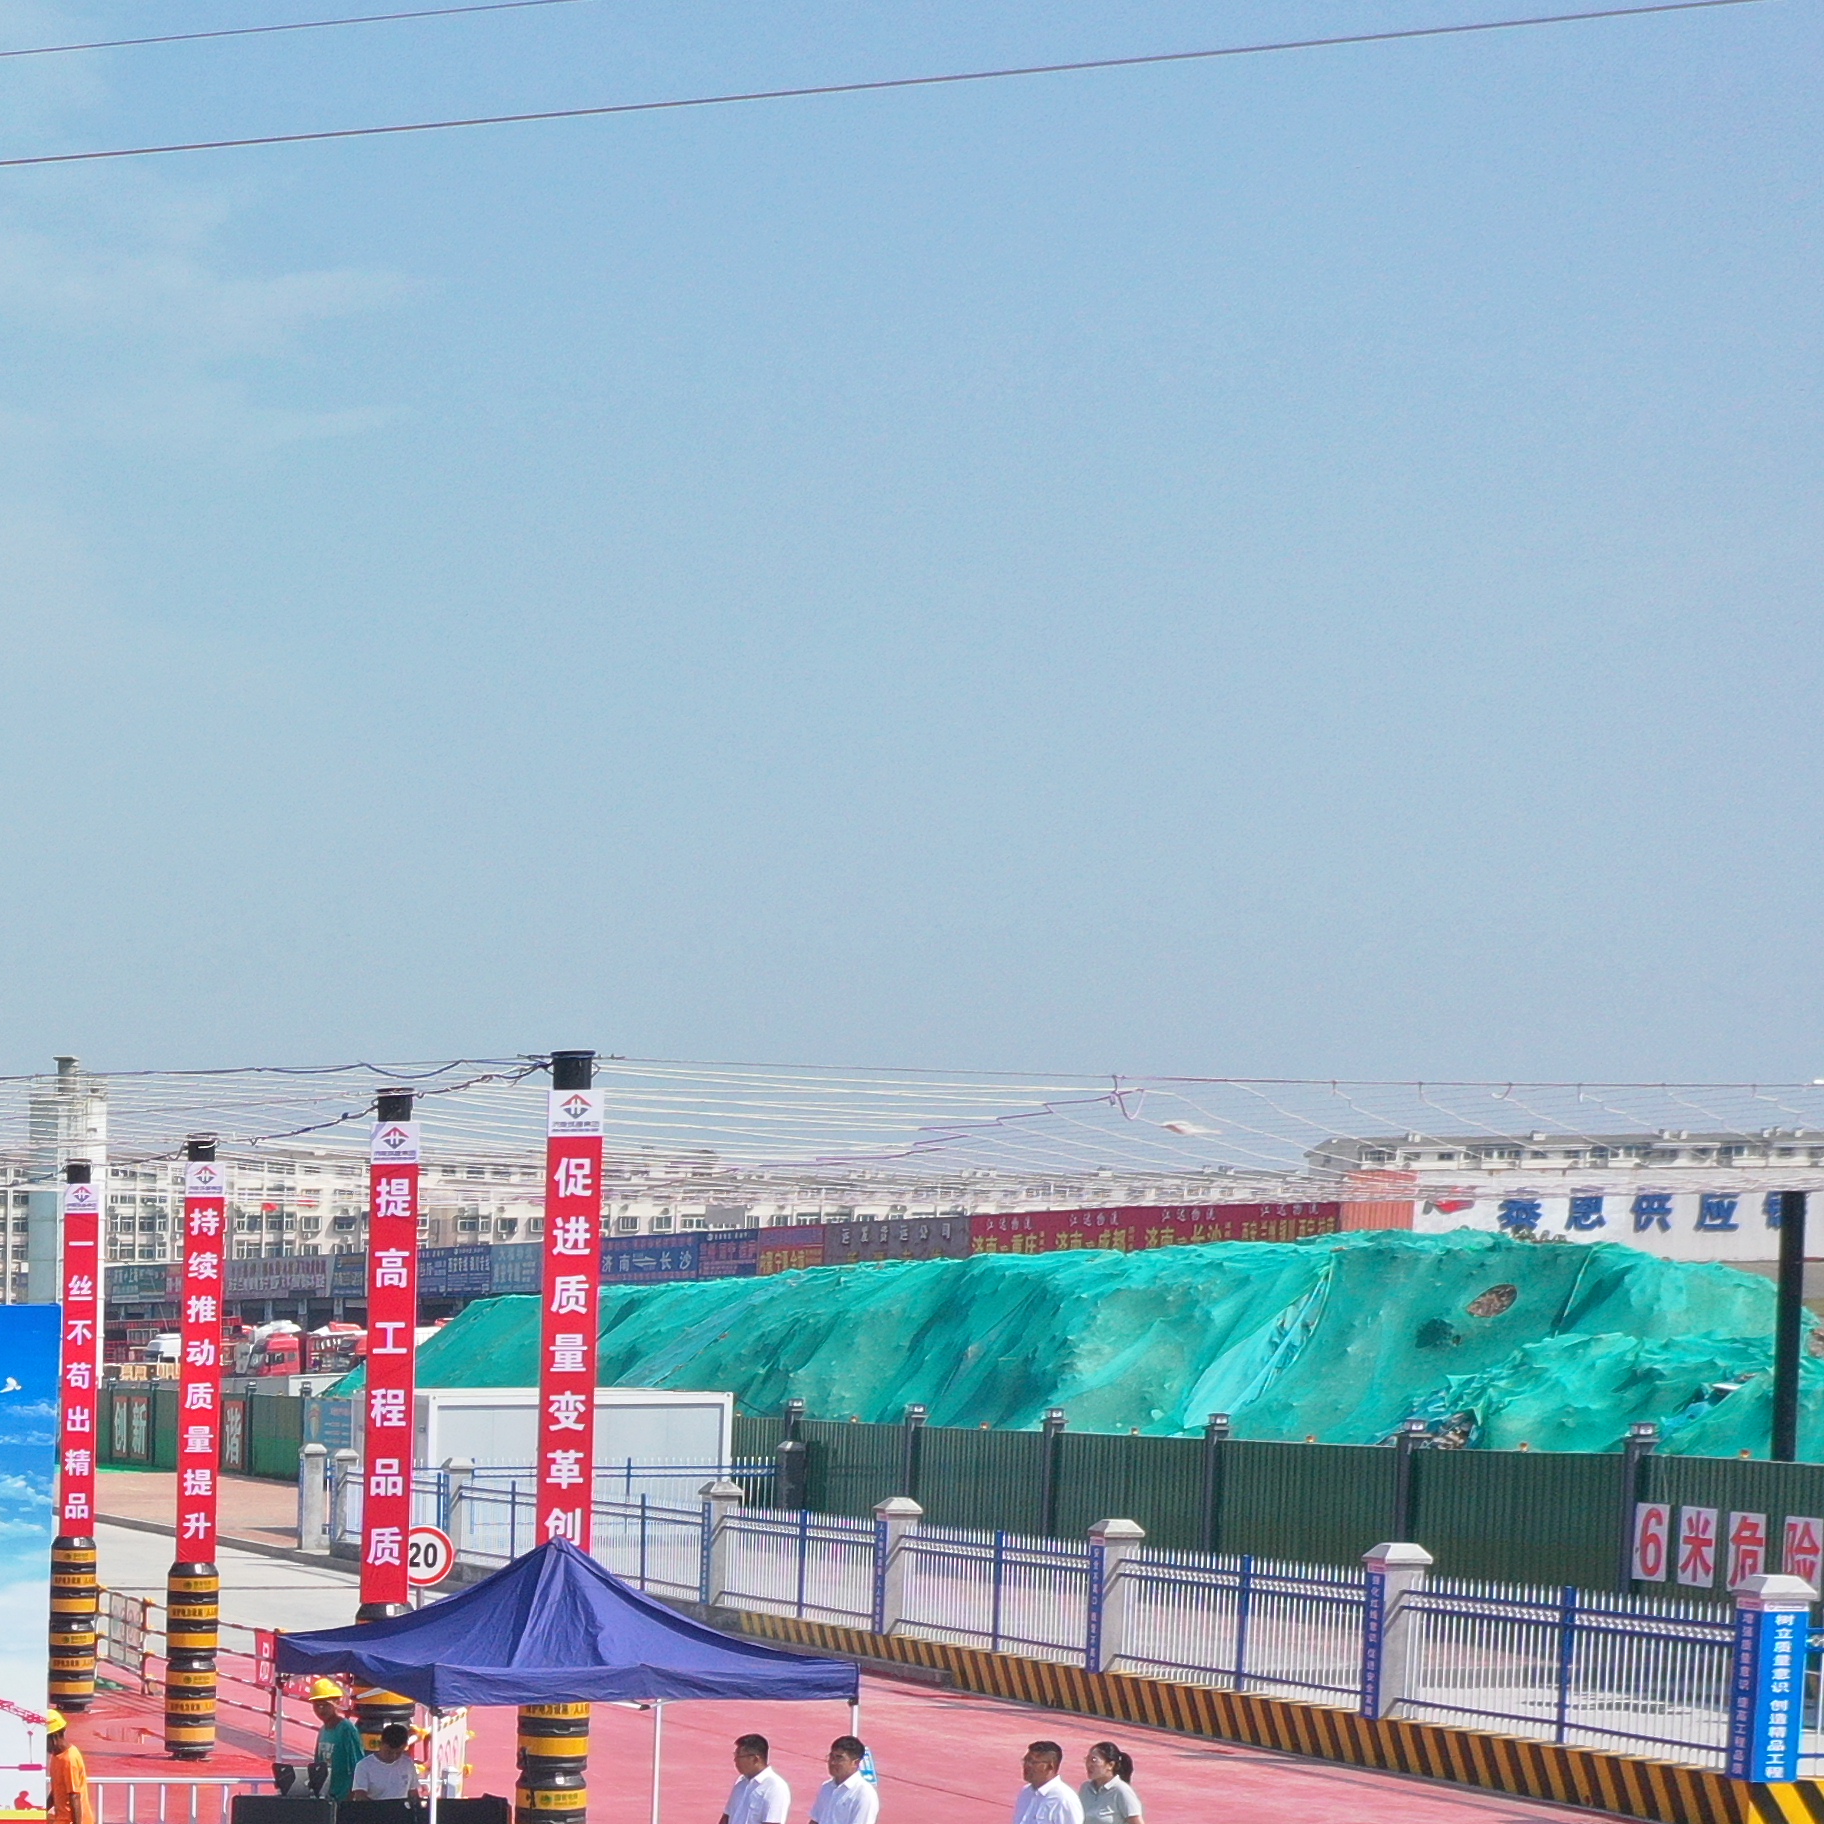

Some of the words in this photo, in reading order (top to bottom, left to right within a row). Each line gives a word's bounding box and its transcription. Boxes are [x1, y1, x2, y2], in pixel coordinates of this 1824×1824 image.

[65, 1241, 95, 1519] 一丝不苟出精品
[183, 1208, 221, 1539] 持续推动质量提升
[366, 1177, 413, 1568] 提高工程品质
[114, 1401, 147, 1455] 创新
[409, 1542, 438, 1568] 20
[1771, 1614, 1796, 1694] 树立质量意识
[1764, 1698, 1790, 1780] 创造精品工程
